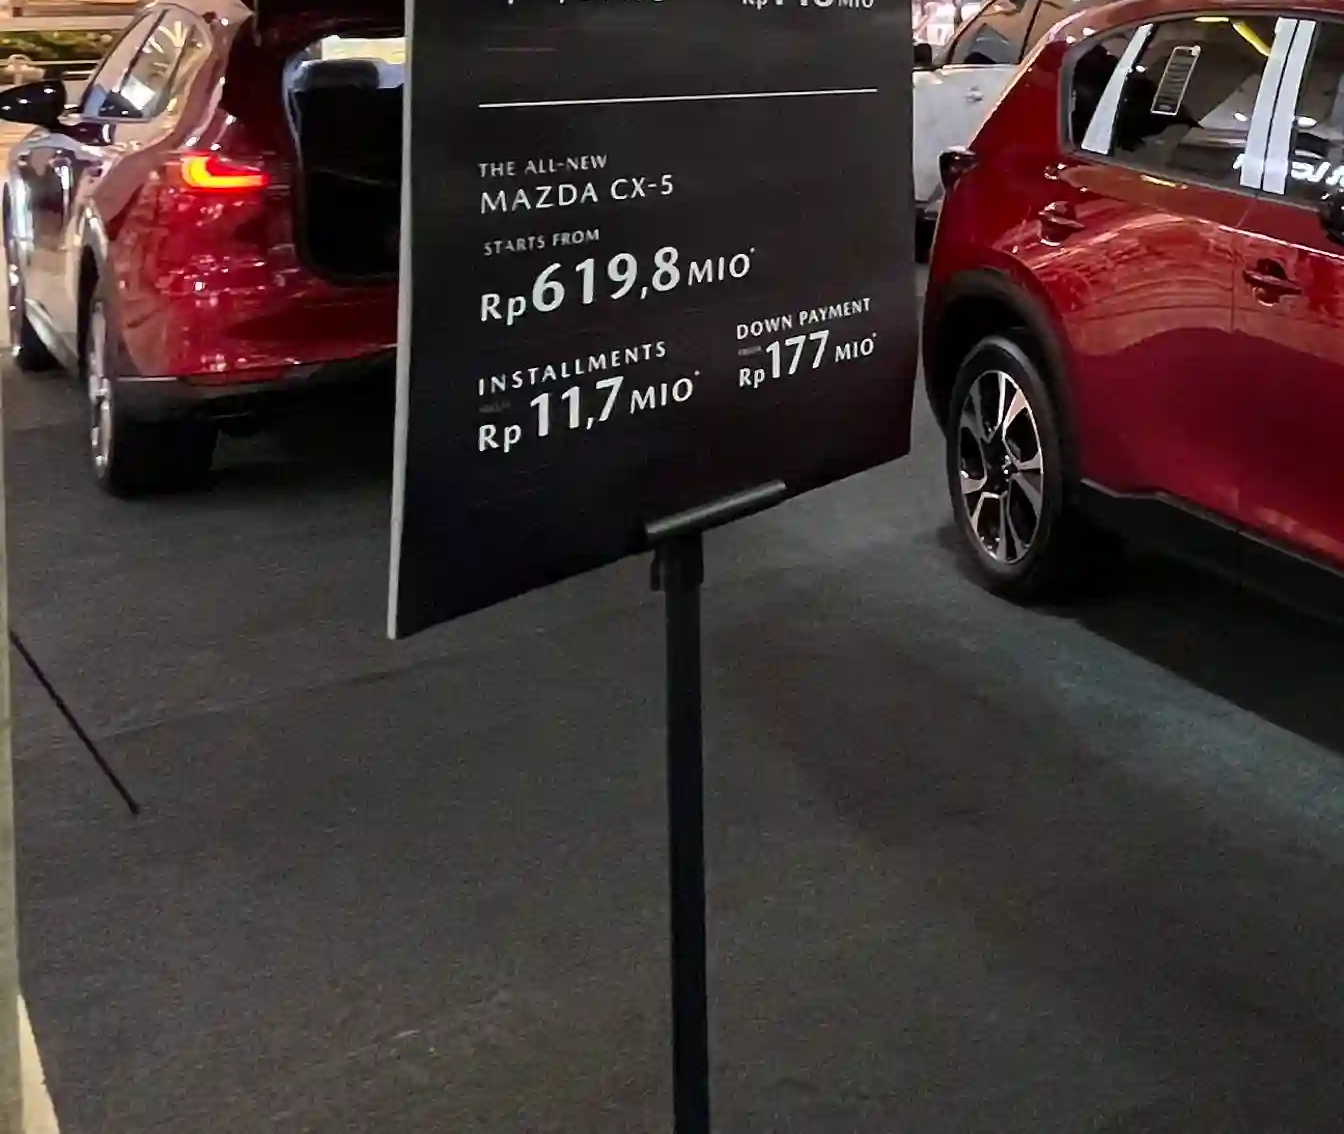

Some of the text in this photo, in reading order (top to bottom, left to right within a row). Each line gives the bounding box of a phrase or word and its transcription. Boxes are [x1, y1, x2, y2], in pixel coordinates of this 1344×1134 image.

[478, 153, 609, 179] THE ALL-NEW
[479, 173, 675, 216] MAZDA CX-5
[483, 227, 601, 257] STARTS FROM
[735, 297, 872, 341] DOWN PAYMENT
[477, 340, 667, 397] INSTALLMENTS
